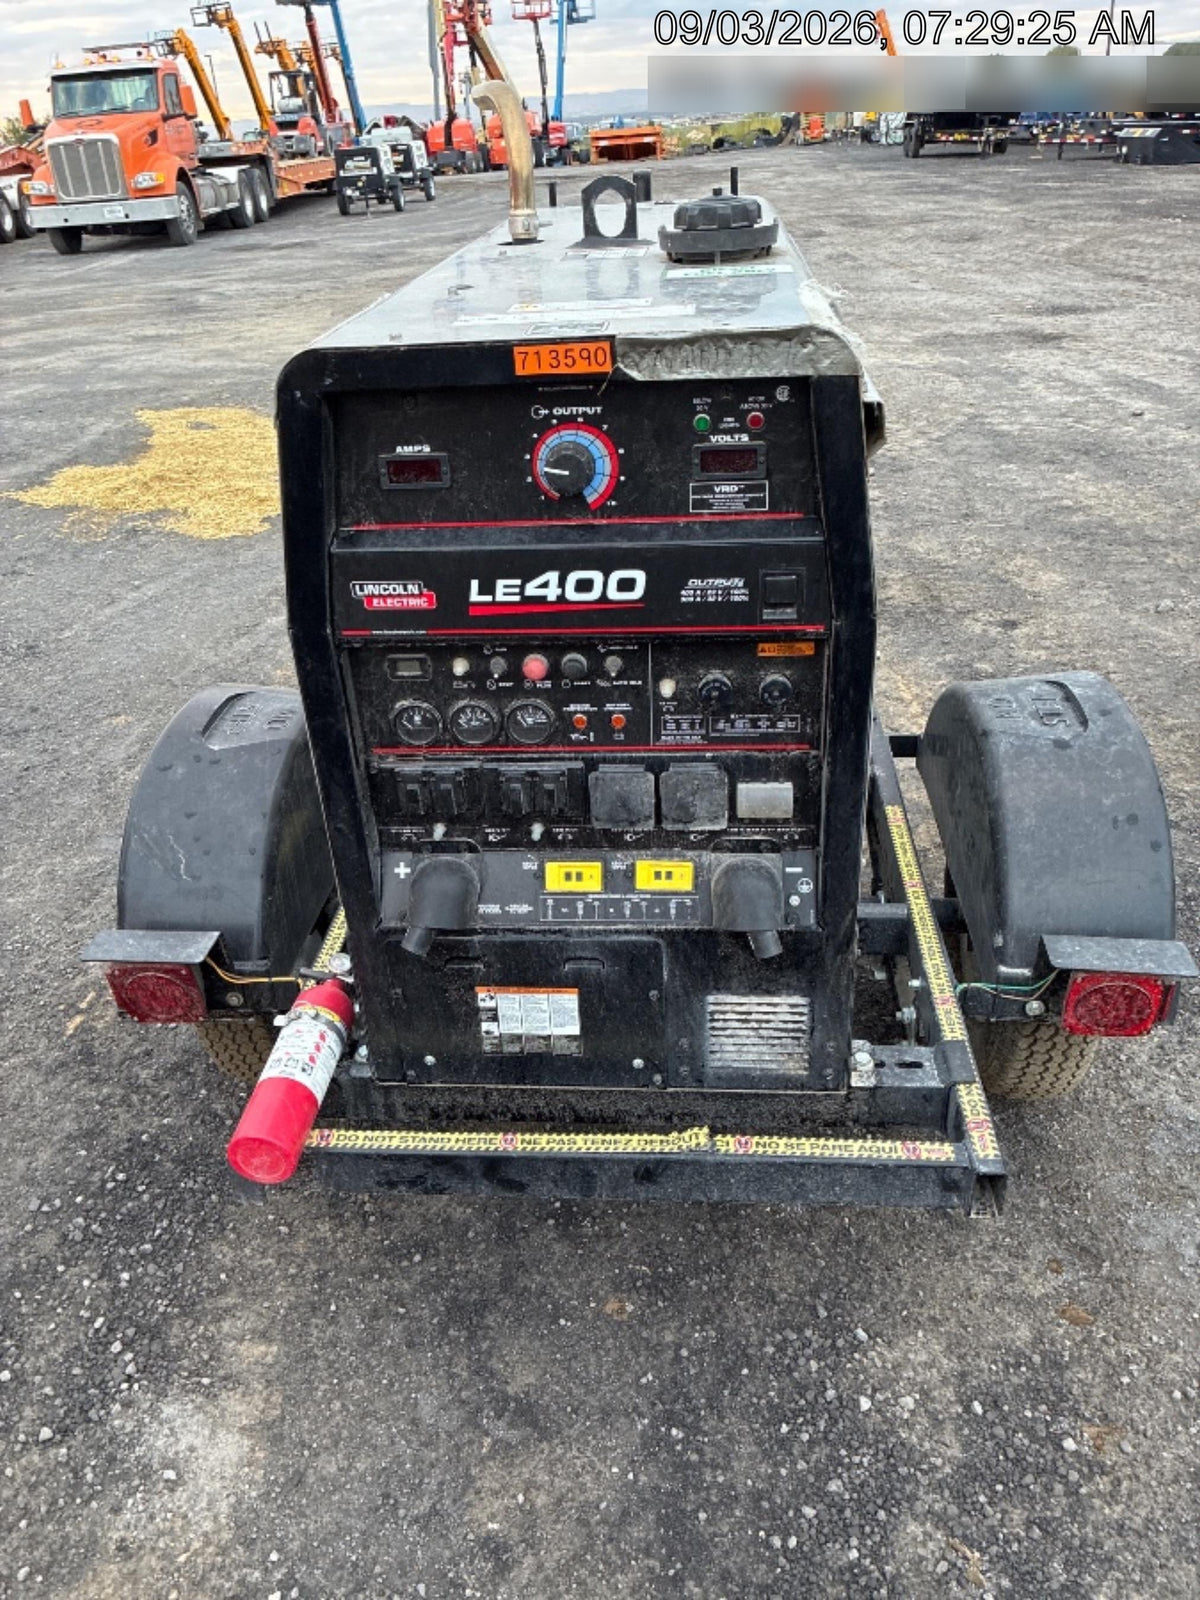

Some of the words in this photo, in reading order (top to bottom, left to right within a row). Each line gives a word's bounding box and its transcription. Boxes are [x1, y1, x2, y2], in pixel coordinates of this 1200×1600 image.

[518, 346, 608, 370] 713590
[552, 406, 603, 415] OUTPUT
[708, 433, 750, 444] VOLTS
[395, 444, 432, 453] AMPS
[354, 584, 421, 596] LINCOLN
[468, 568, 646, 603] LE400
[372, 597, 430, 607] ELECTRIC
[336, 1133, 358, 1144] DO
[362, 1134, 396, 1144] NOT
[399, 1134, 452, 1145] STAND
[454, 1136, 500, 1146] HERE
[520, 1136, 543, 1146] NE
[546, 1136, 579, 1146] PAS
[582, 1137, 633, 1147] TENEZ
[755, 1138, 780, 1150] NO
[784, 1140, 806, 1152] SE
[809, 1141, 853, 1153] PARE
